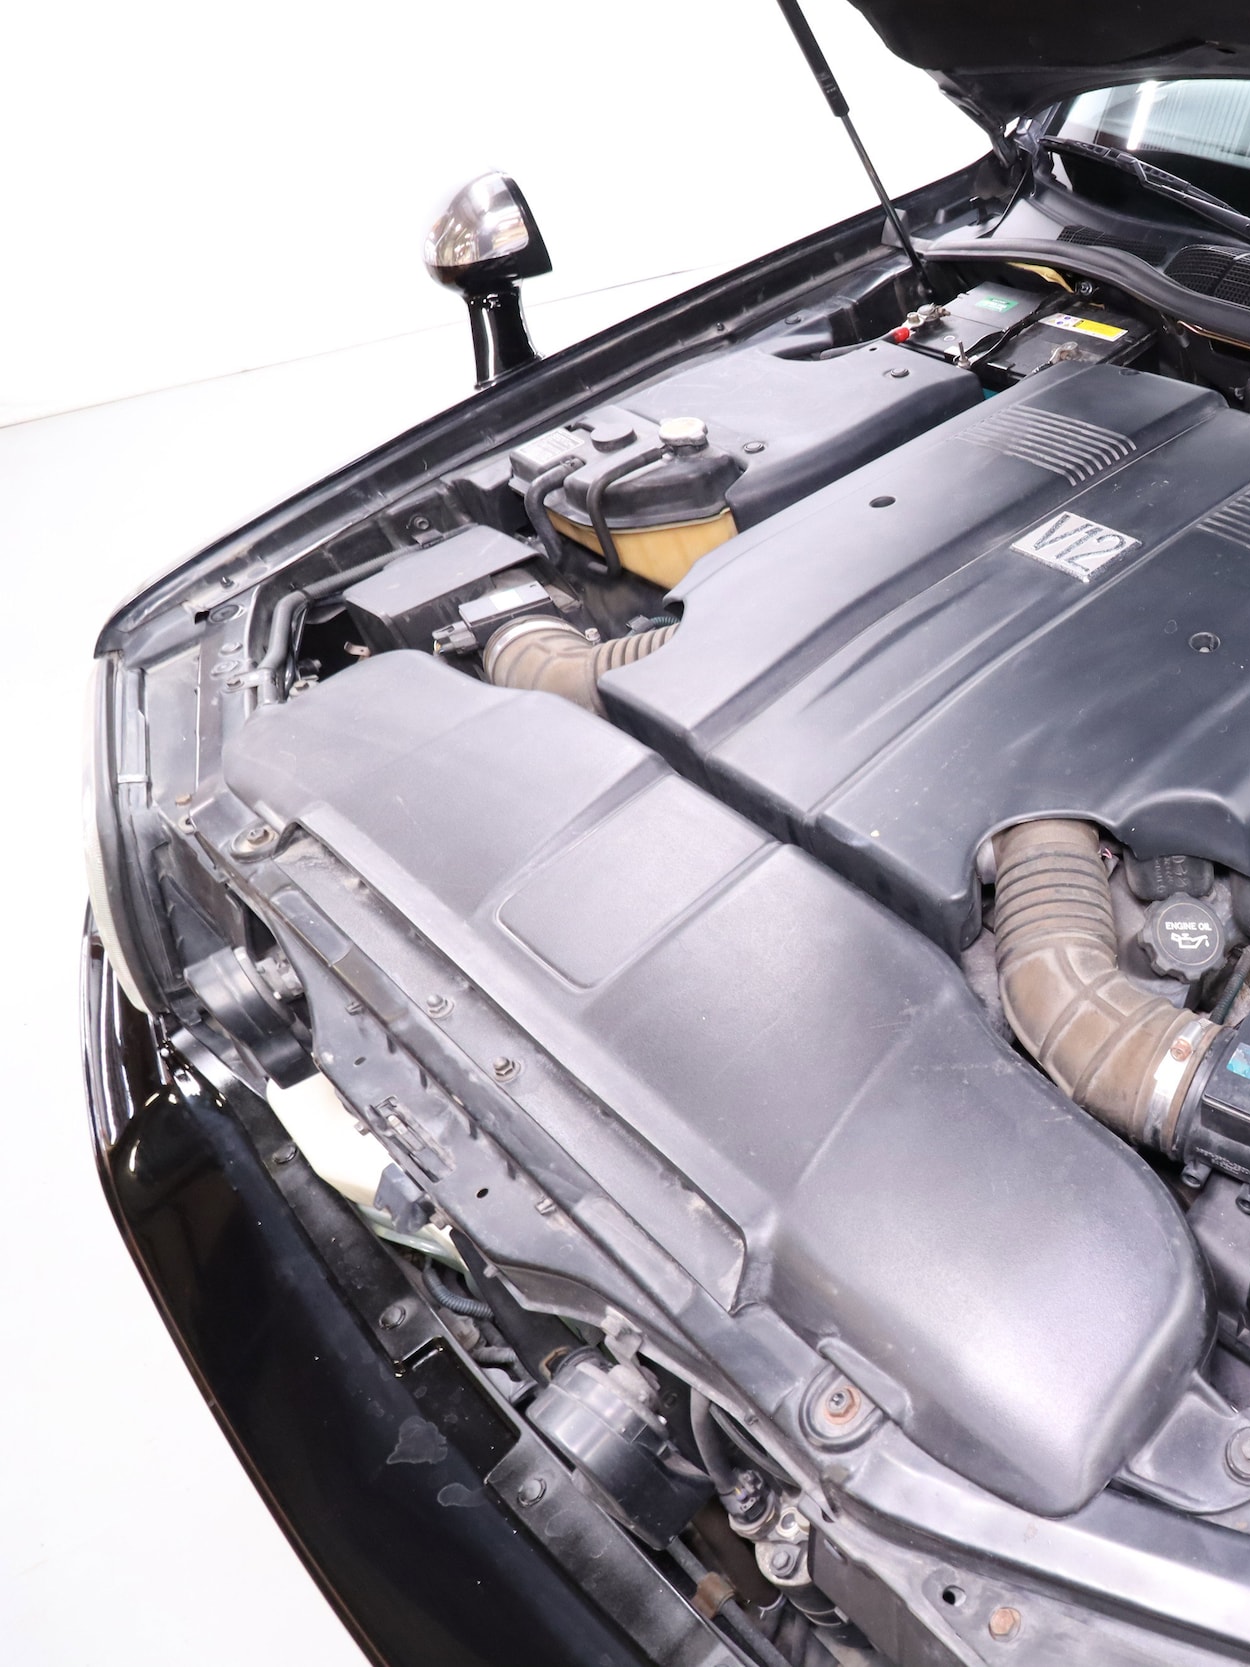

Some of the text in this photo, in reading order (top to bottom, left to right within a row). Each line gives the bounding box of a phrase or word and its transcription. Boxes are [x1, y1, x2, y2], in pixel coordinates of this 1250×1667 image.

[1034, 514, 1127, 572] V12
[1165, 921, 1213, 931] ENGINE OIL
